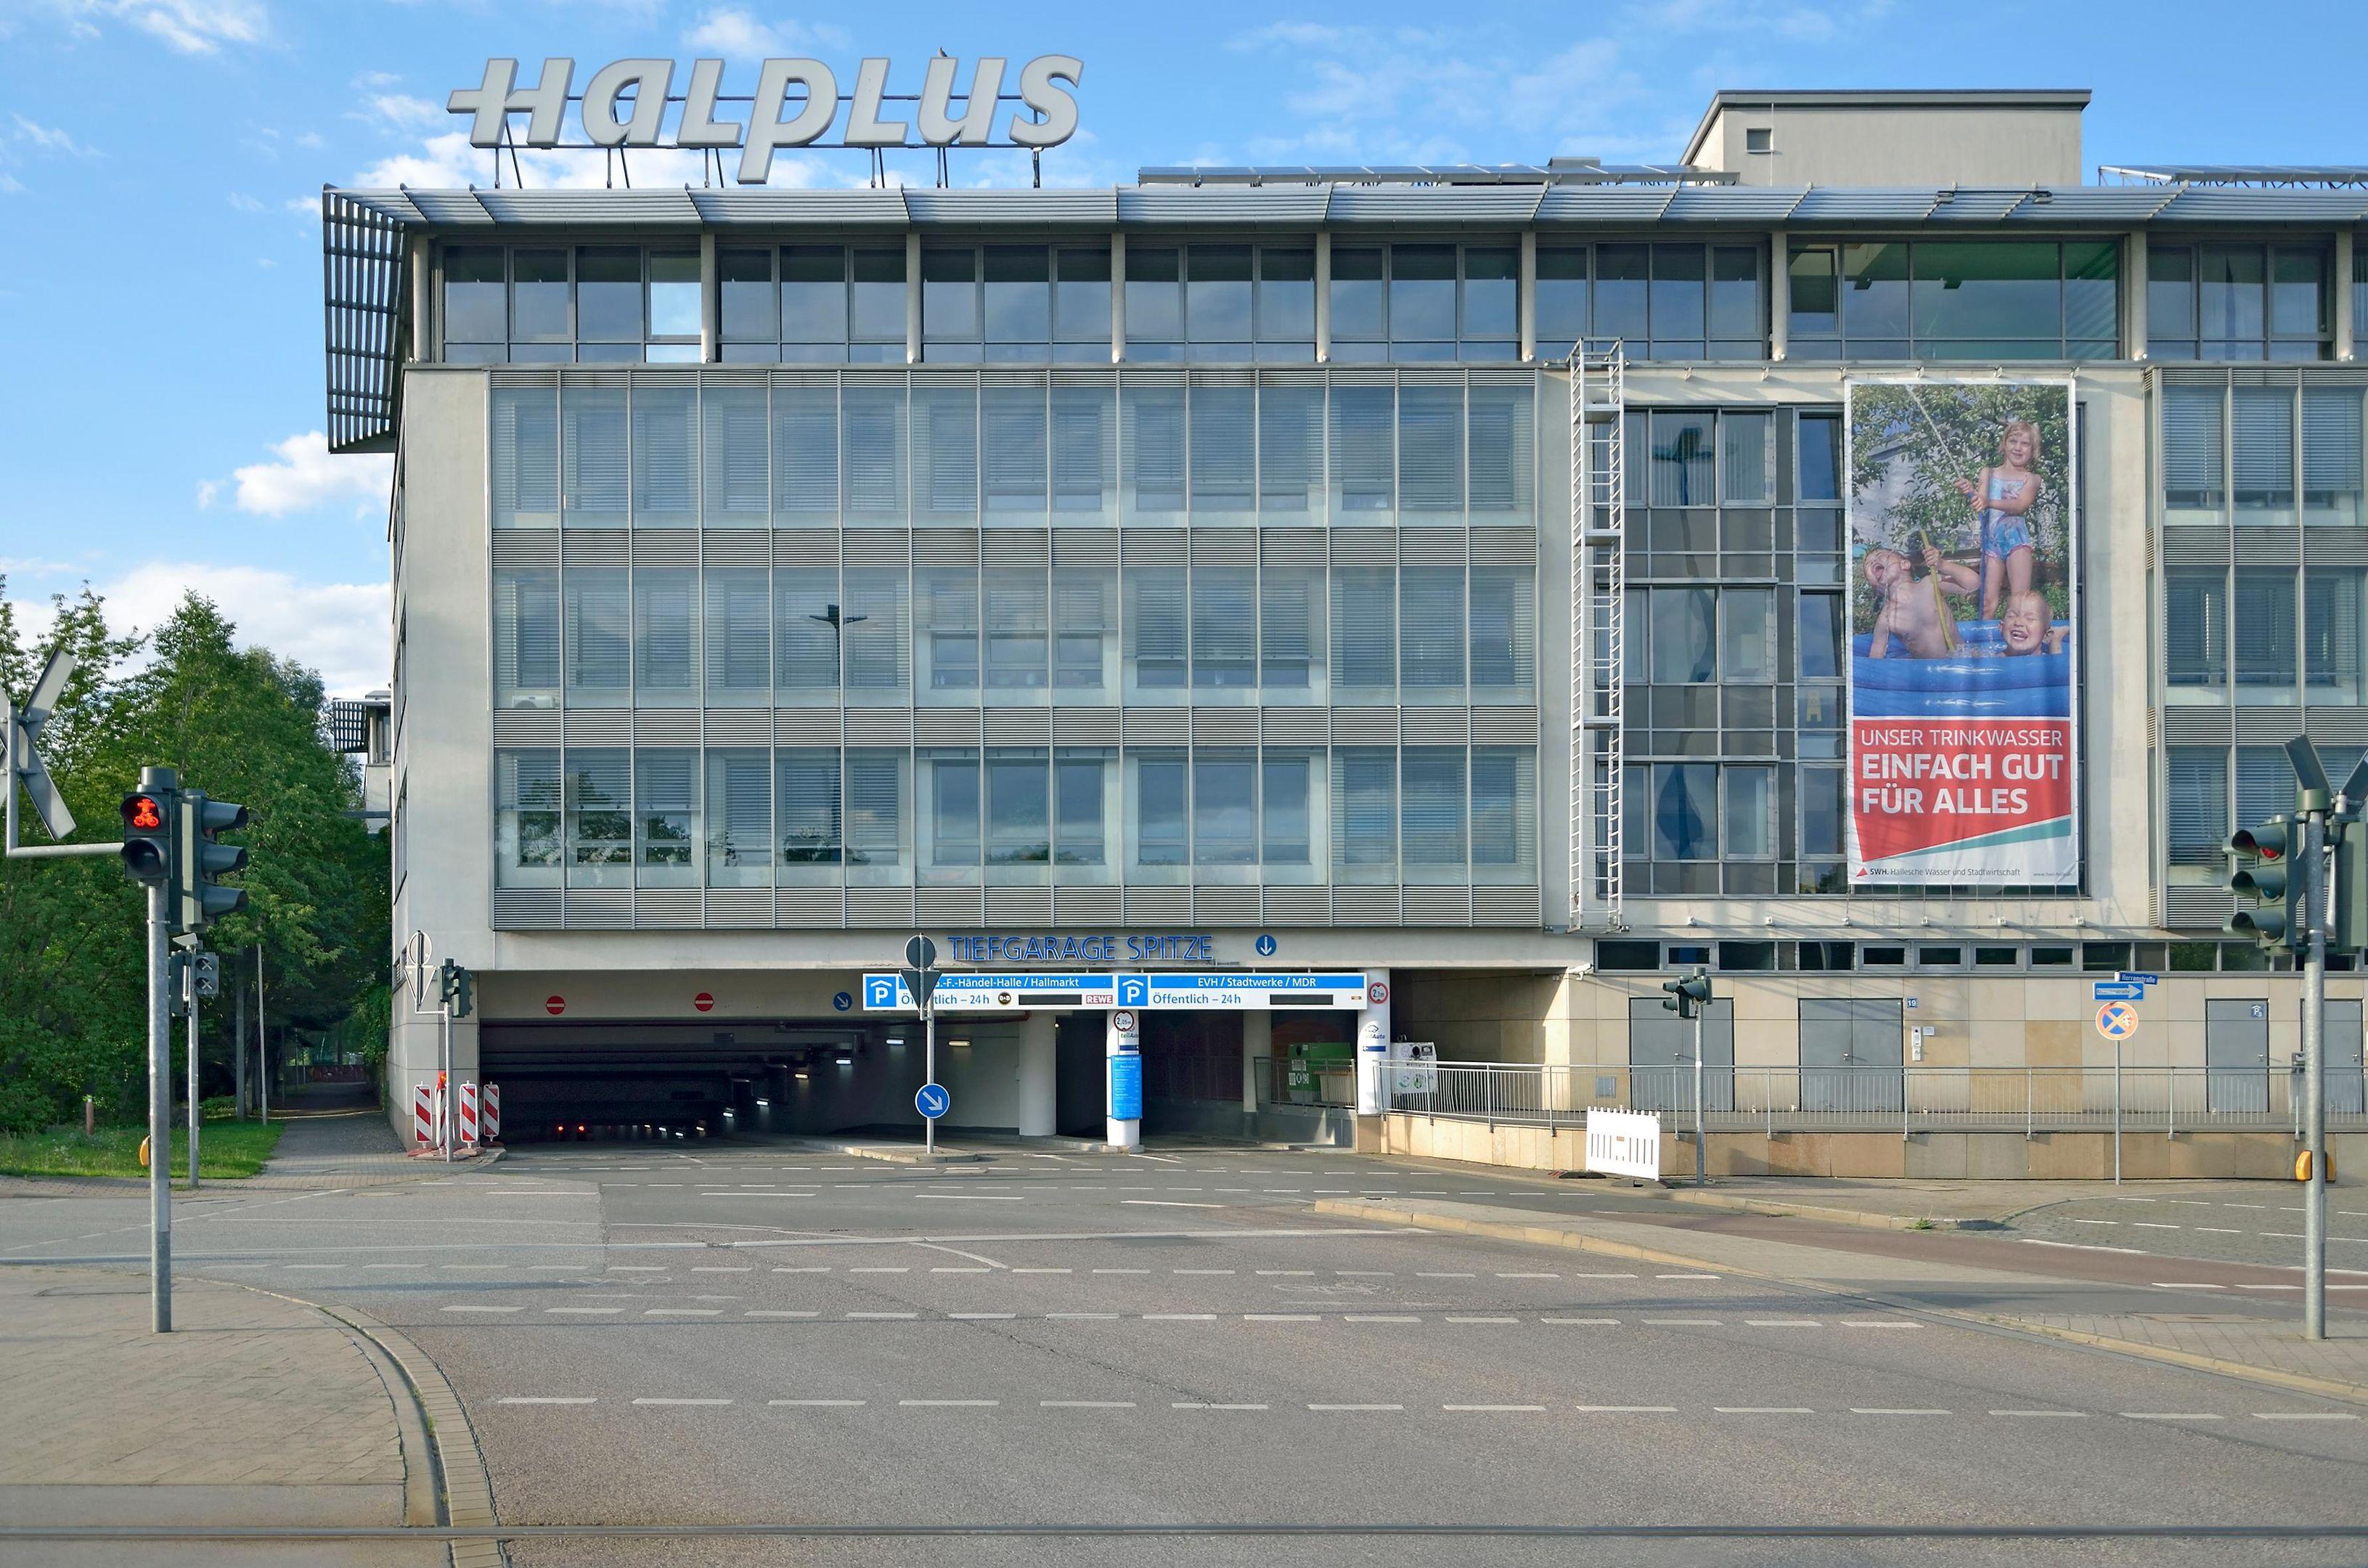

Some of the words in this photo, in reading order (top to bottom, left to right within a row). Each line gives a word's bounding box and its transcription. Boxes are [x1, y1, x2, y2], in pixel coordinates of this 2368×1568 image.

[1861, 730, 1924, 746] UNSER
[1930, 730, 2062, 746] TRINKWASSER
[1862, 754, 1991, 779] EINFACH
[2002, 754, 2063, 779] GUT
[1862, 783, 1924, 813] FÜR
[1932, 788, 2028, 814] ALLES
[947, 936, 1115, 960] TIEFGARAGE
[1127, 936, 1213, 960] SPITZE
[1031, 976, 1079, 987] Hallmarkt
[1198, 978, 1218, 987] EVH
[1227, 977, 1283, 987] Stadtwerke
[1292, 978, 1316, 987] MDR
[1087, 995, 1113, 1004] REWE
[1153, 992, 1209, 1004] Öffentlich
